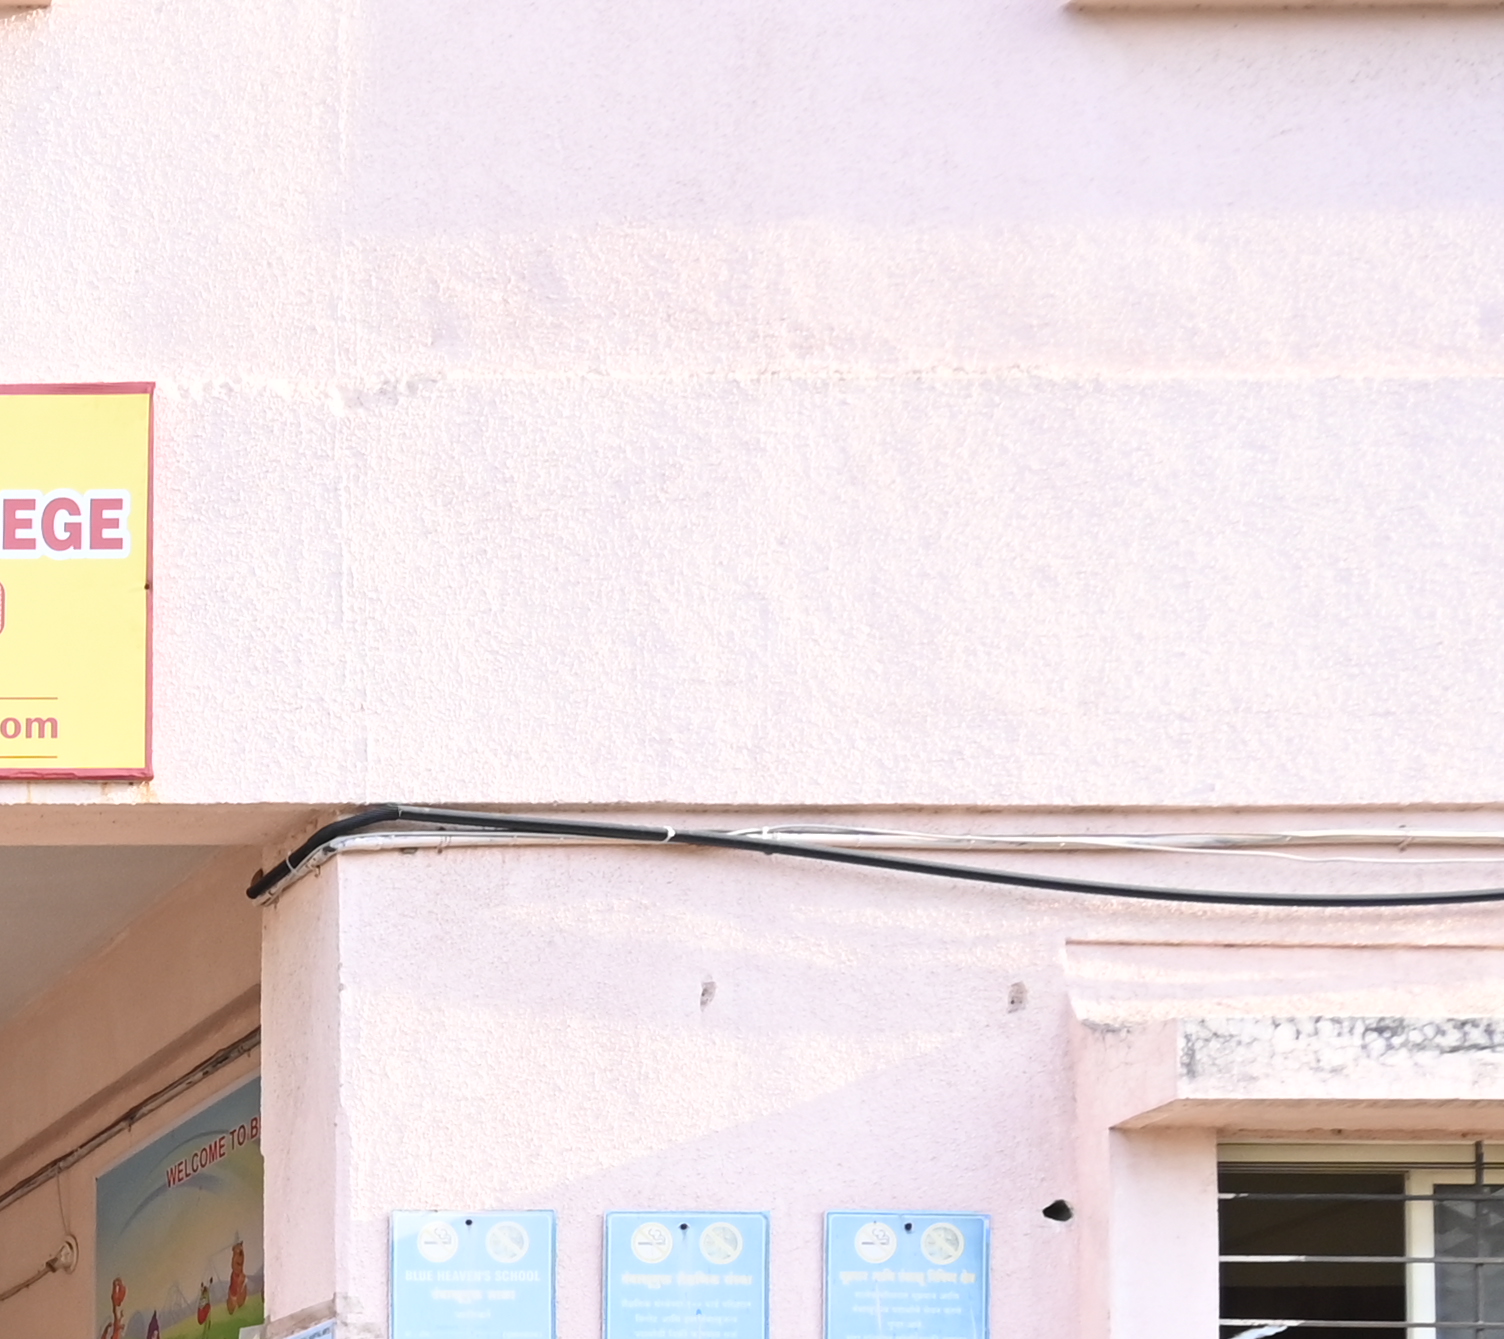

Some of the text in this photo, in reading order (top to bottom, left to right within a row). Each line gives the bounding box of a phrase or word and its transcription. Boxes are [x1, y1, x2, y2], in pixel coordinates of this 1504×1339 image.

[166, 1116, 261, 1188] WELCOME TO B
[495, 1271, 540, 1283] SCHOOL
